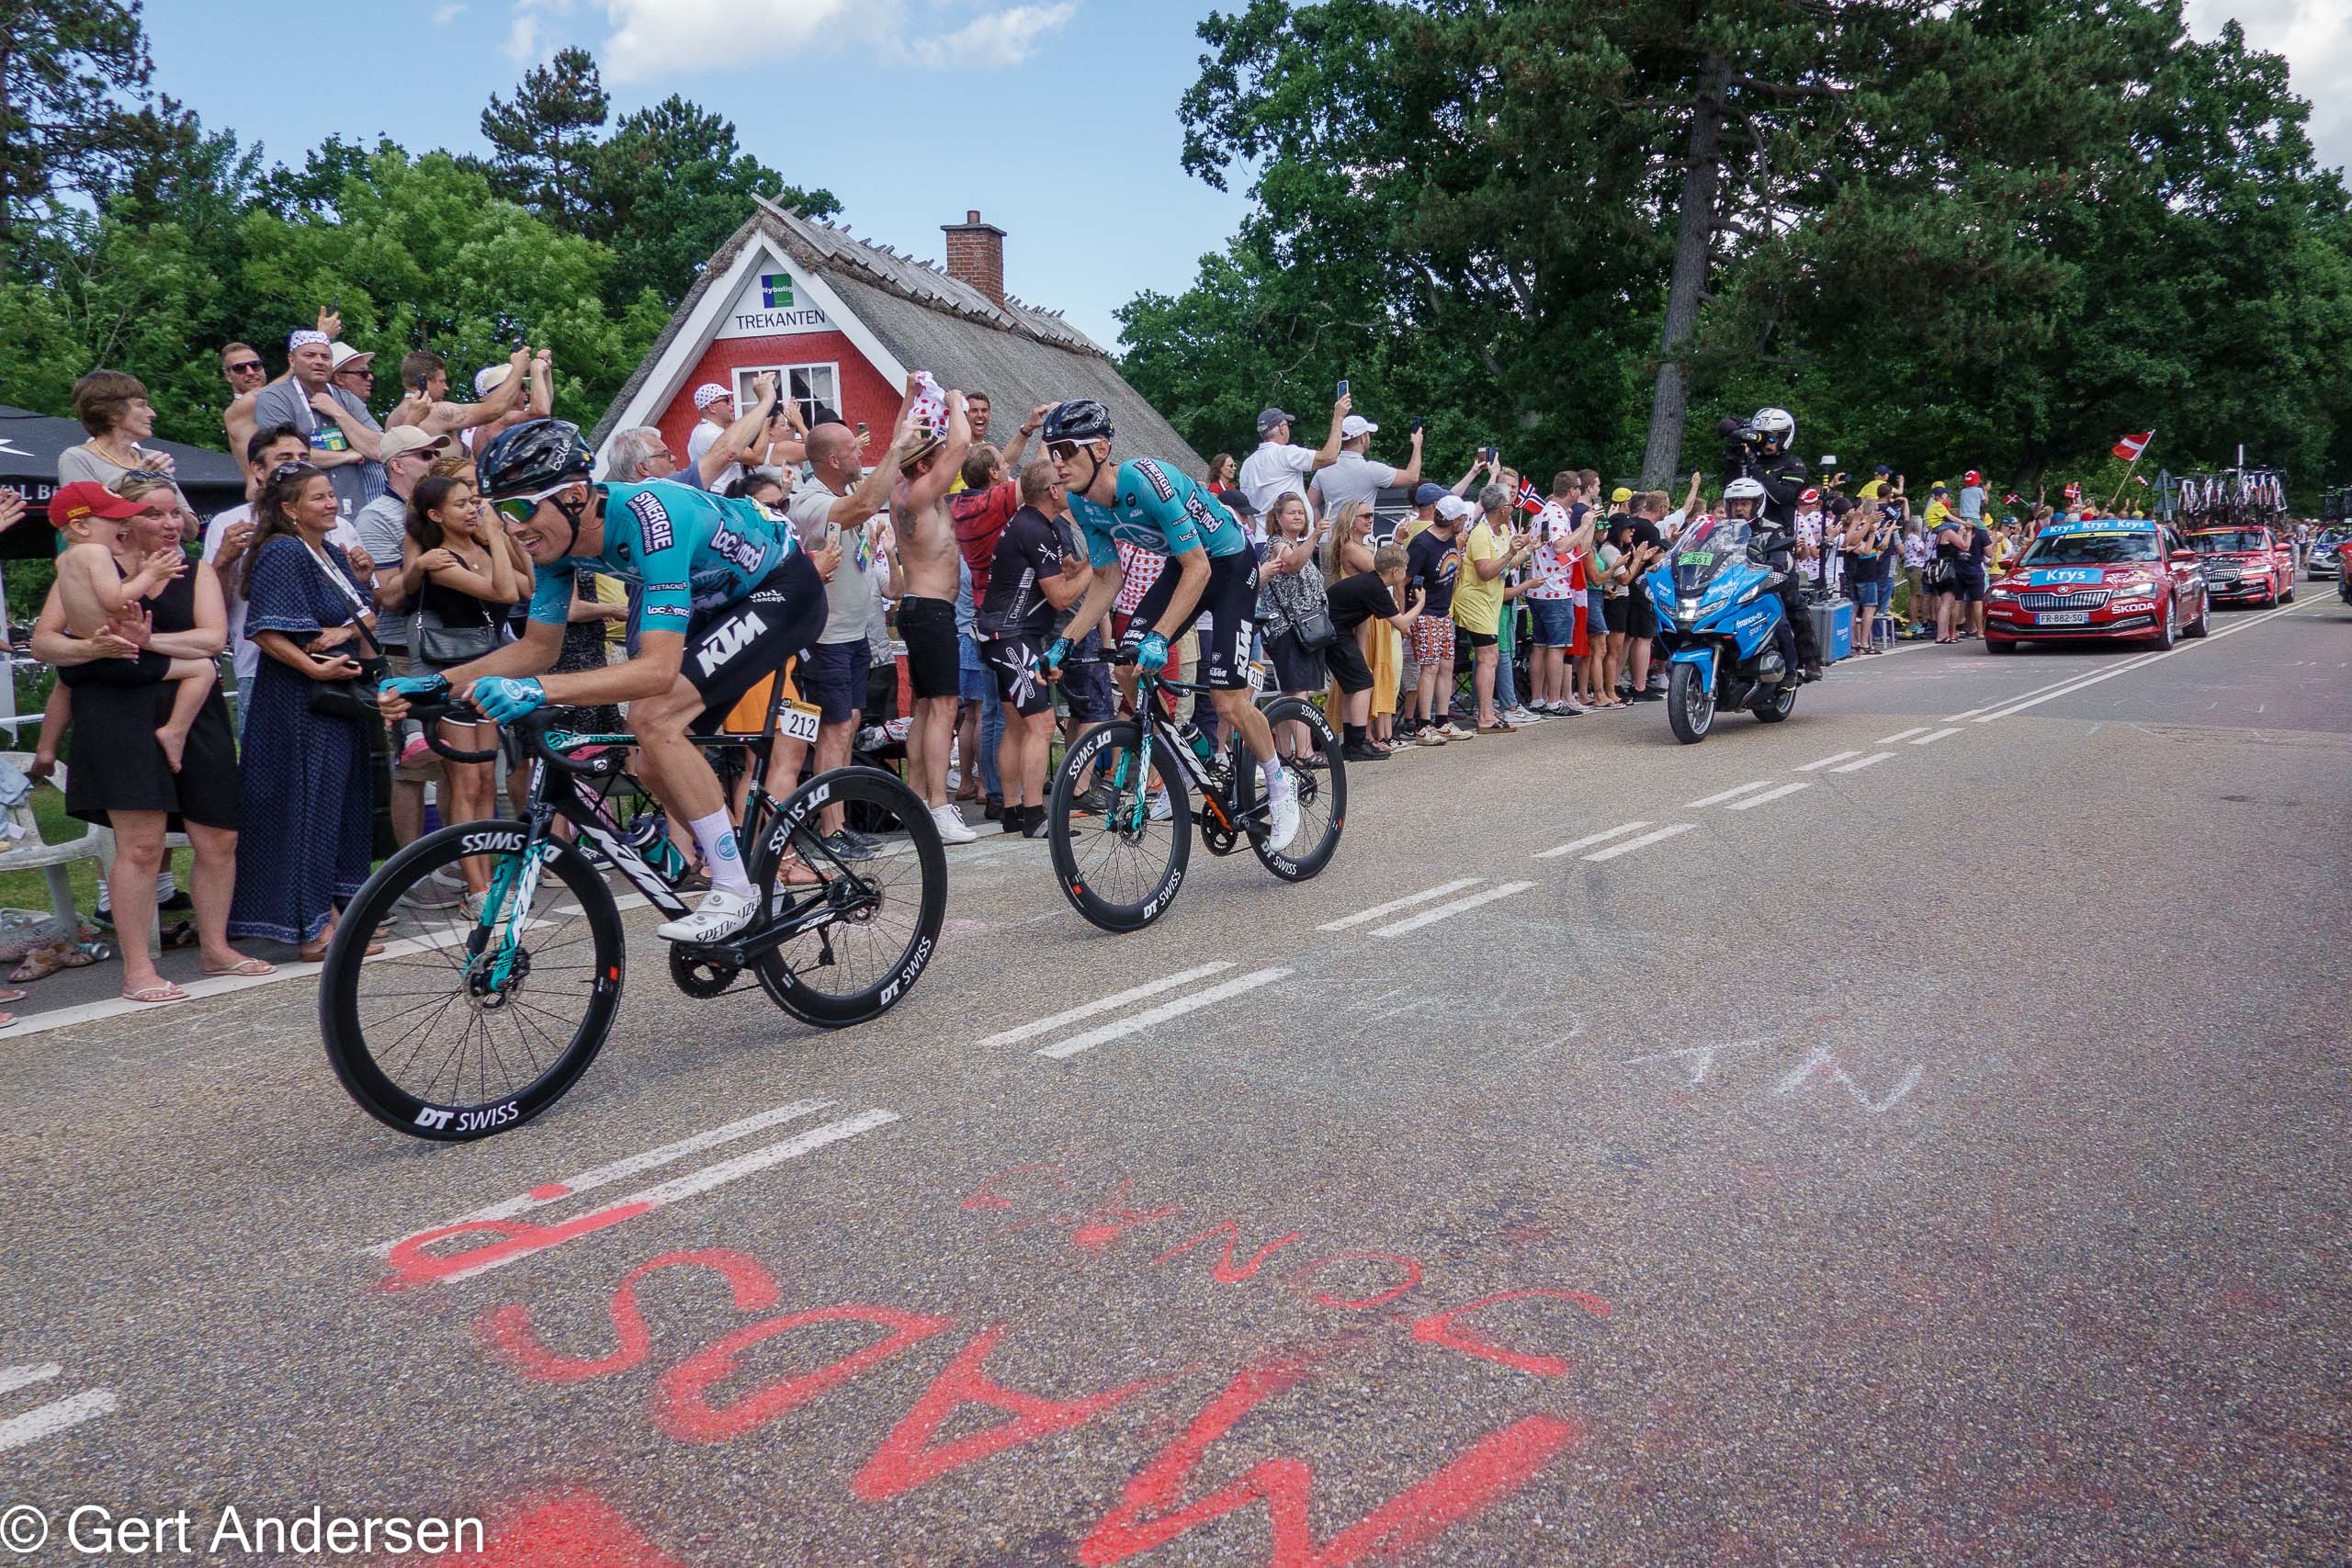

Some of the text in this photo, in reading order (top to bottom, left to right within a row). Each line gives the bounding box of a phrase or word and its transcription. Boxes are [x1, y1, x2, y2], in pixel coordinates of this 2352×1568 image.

[736, 310, 826, 330] TREKANTEN
[1140, 459, 1174, 500] SYNERGIE
[634, 491, 673, 549] SYNERGIE
[2050, 520, 2146, 534] Krys Krys Krys
[1690, 556, 1708, 564] 561
[2046, 570, 2086, 582] Krys
[1009, 590, 1028, 619] Danske
[2041, 615, 2083, 623] FR-882-SQ
[696, 611, 768, 678] KTM
[1235, 619, 1253, 679] KTM
[1250, 670, 1262, 688] 217
[788, 714, 816, 739] 212
[1301, 704, 1334, 742] DT SWISS
[1069, 730, 1112, 780] DT SWISS
[1160, 720, 1214, 786] KTM
[808, 783, 830, 810] DT
[461, 831, 527, 855] SWISS
[1261, 841, 1297, 875] DT SWISS
[580, 825, 684, 909] KTM
[1143, 867, 1182, 919] DT SWISS
[880, 936, 933, 1007] DT SWISS
[413, 1100, 519, 1132] DT SWISS
